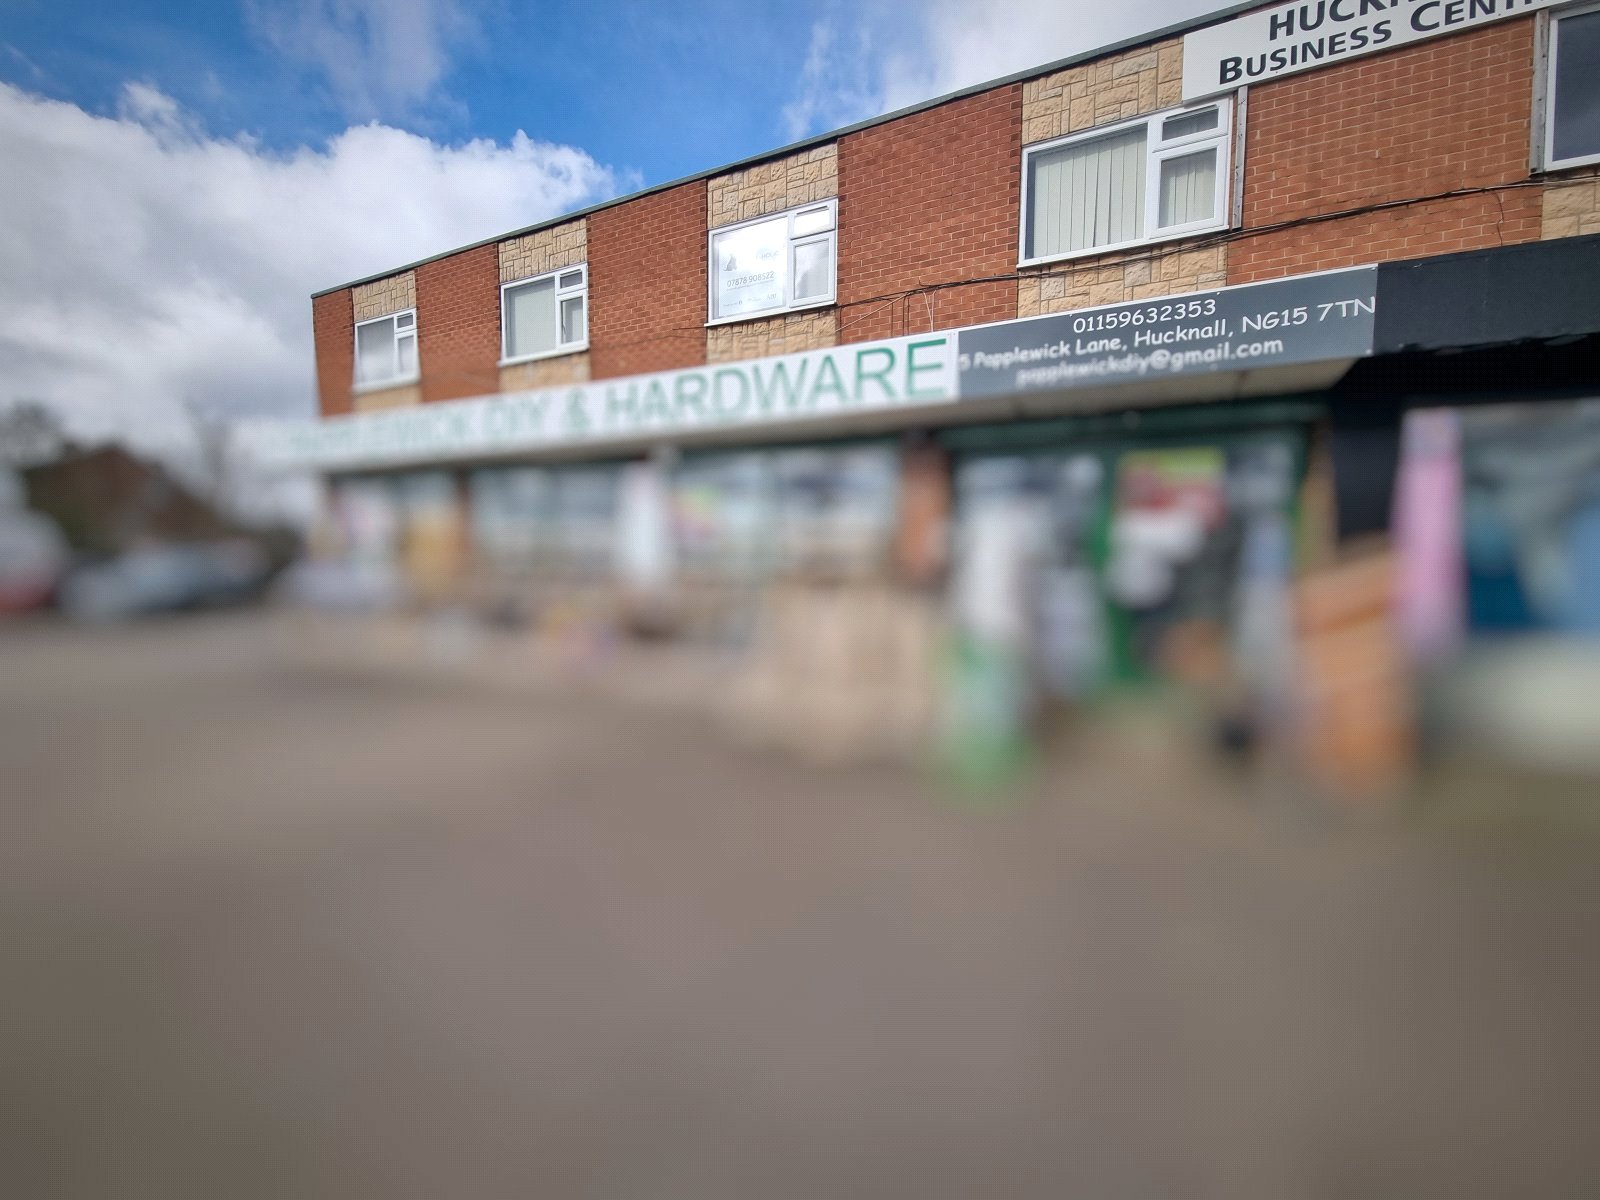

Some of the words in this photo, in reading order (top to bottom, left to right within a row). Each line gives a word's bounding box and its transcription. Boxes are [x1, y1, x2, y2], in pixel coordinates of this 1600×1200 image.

[1269, 0, 1419, 41] HUCK
[1219, 20, 1392, 85] BUSINESS
[1073, 299, 1216, 333] 01159632353
[1075, 337, 1128, 355] Lane,
[1134, 318, 1234, 347] Hucknall,
[1242, 306, 1308, 333] NG15
[1316, 296, 1376, 322] 7TN
[603, 338, 947, 422] HARDWARE
